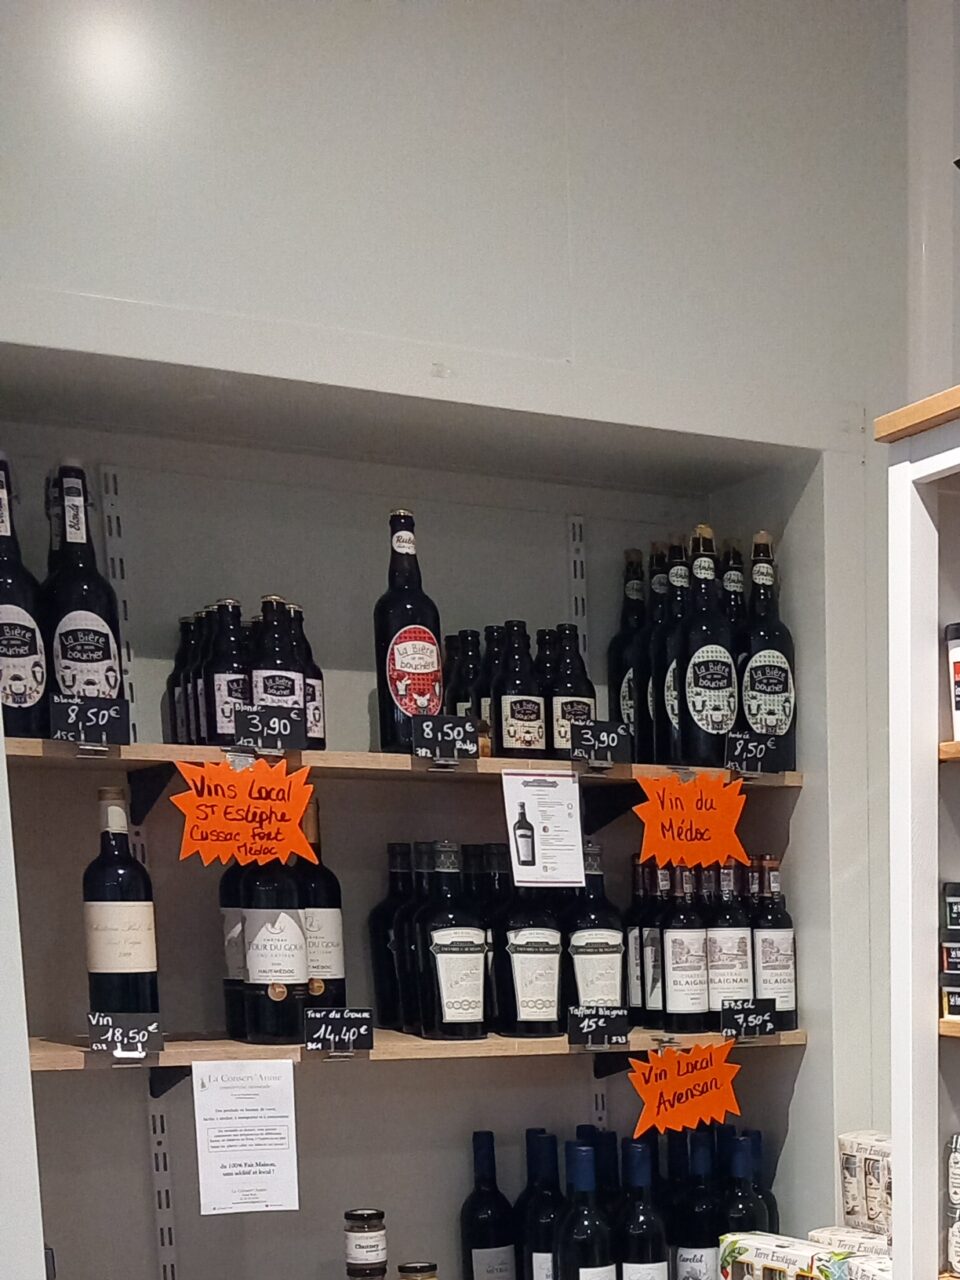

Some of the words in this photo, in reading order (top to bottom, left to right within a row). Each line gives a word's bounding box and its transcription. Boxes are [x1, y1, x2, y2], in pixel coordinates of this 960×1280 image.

[77, 631, 106, 644] Bière
[191, 779, 237, 800] Vins
[249, 779, 293, 802] Local
[656, 791, 685, 812] Vin
[694, 794, 717, 812] du
[190, 824, 241, 843] Cussac
[660, 818, 713, 843] Médoc
[88, 1012, 113, 1027] Vin
[642, 1064, 668, 1085] Vin
[675, 1053, 715, 1078] Local
[655, 1076, 723, 1117] Avensan
